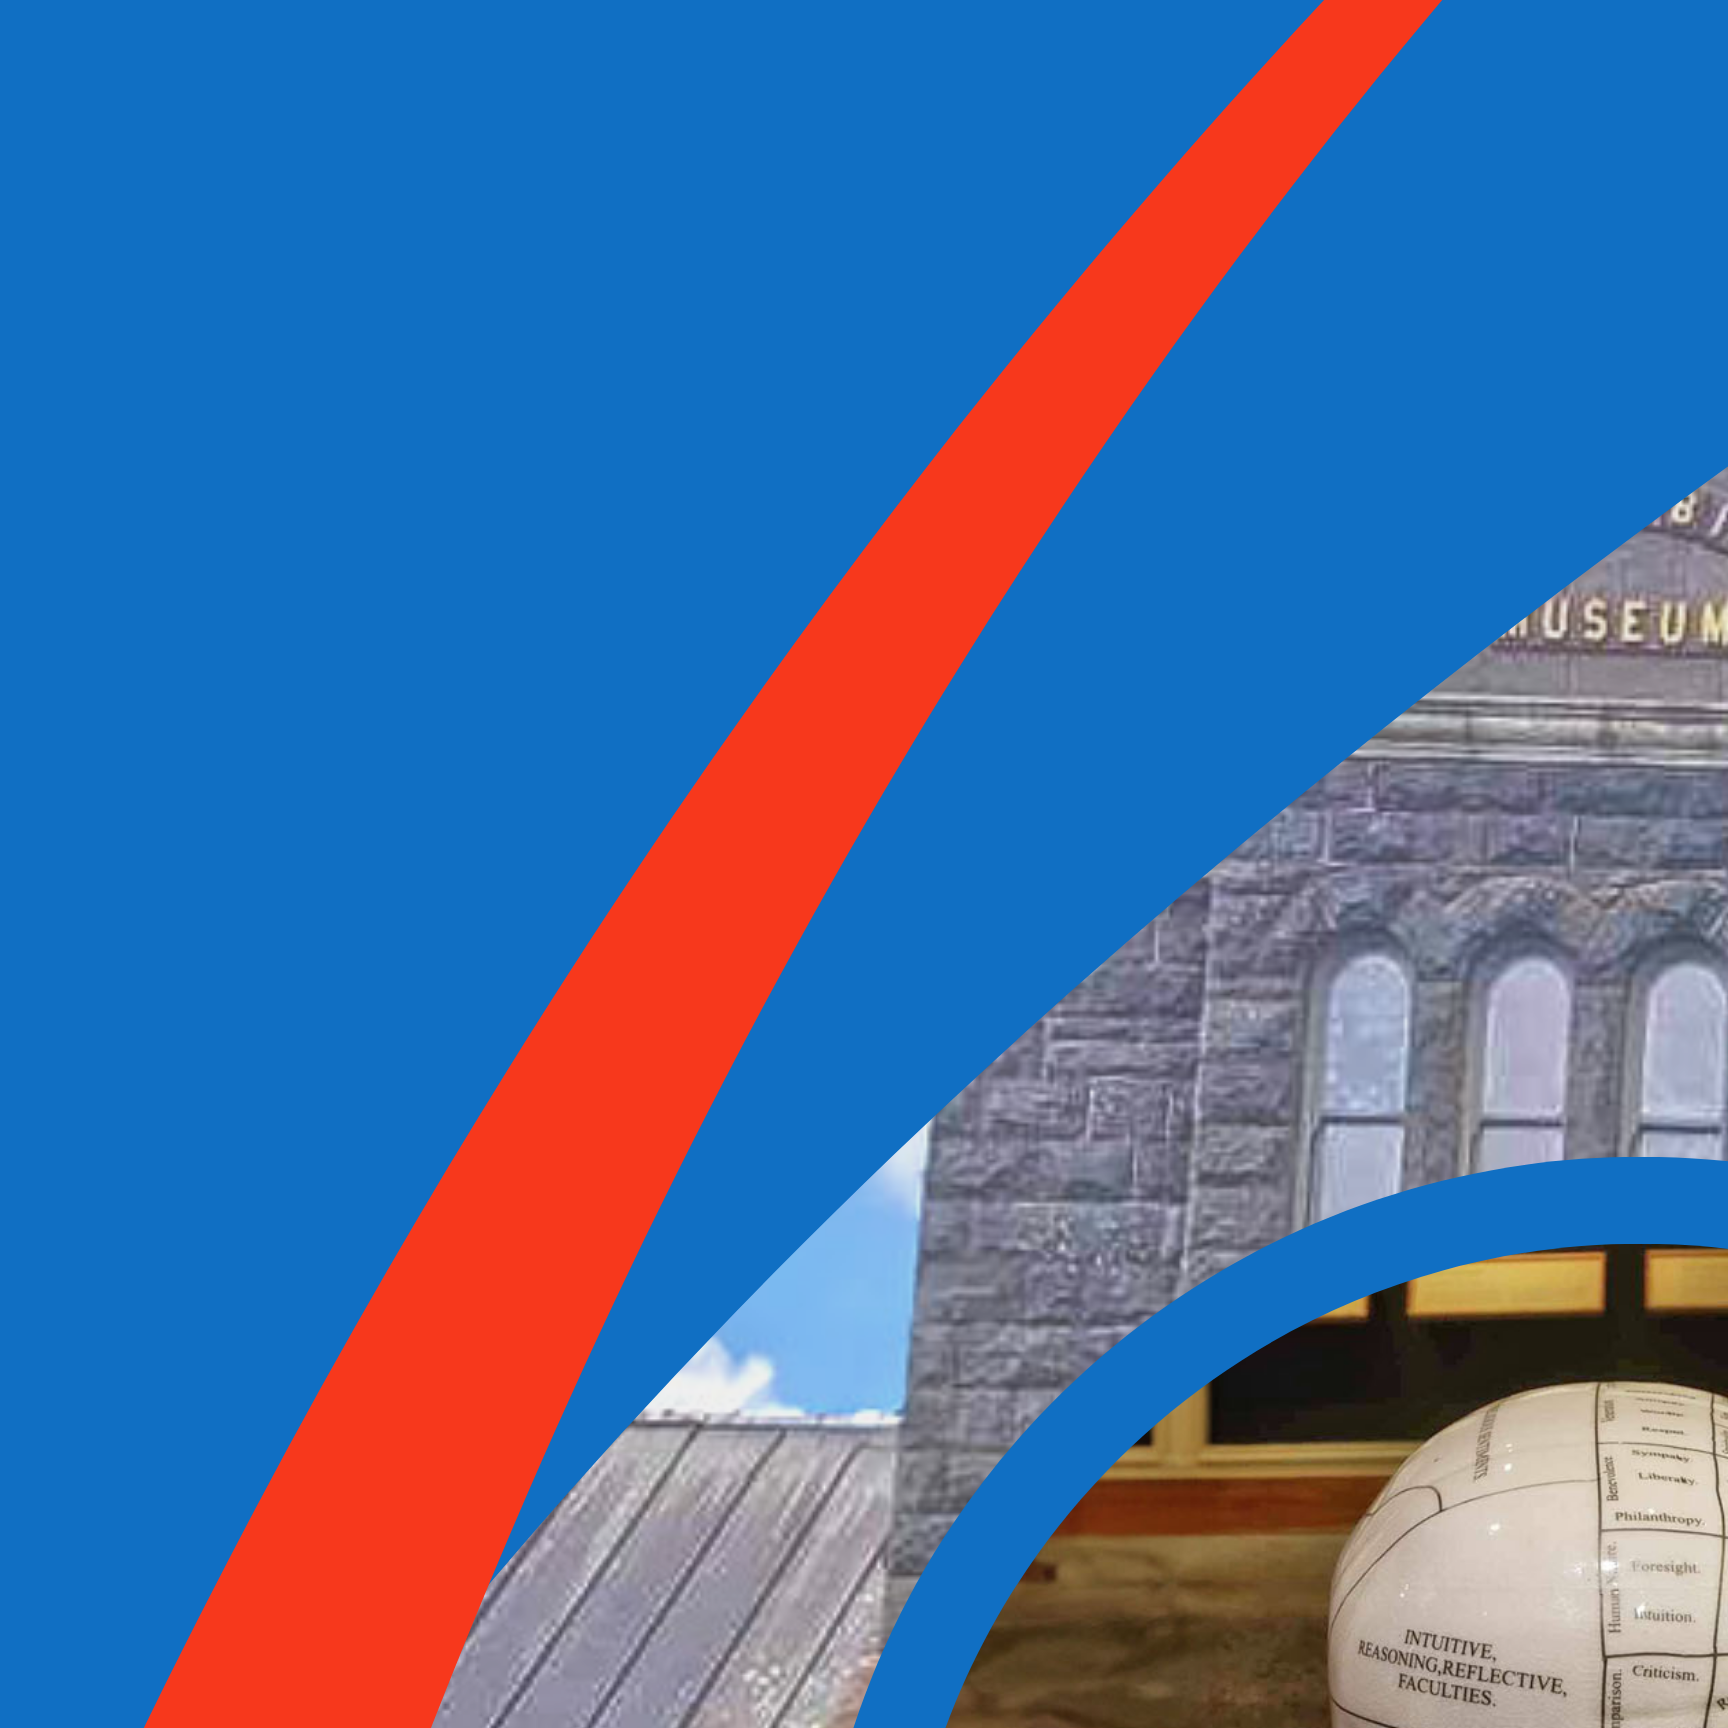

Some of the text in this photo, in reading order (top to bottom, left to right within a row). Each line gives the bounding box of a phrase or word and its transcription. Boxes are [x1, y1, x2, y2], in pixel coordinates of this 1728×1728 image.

[1615, 1511, 1705, 1527] Philanthropy.
[1631, 1560, 1701, 1575] Foresight.
[1404, 1629, 1497, 1662] INTUITIVE,
[1632, 1664, 1699, 1682] Criticism.
[1398, 1673, 1496, 1707] FACULTIES.
